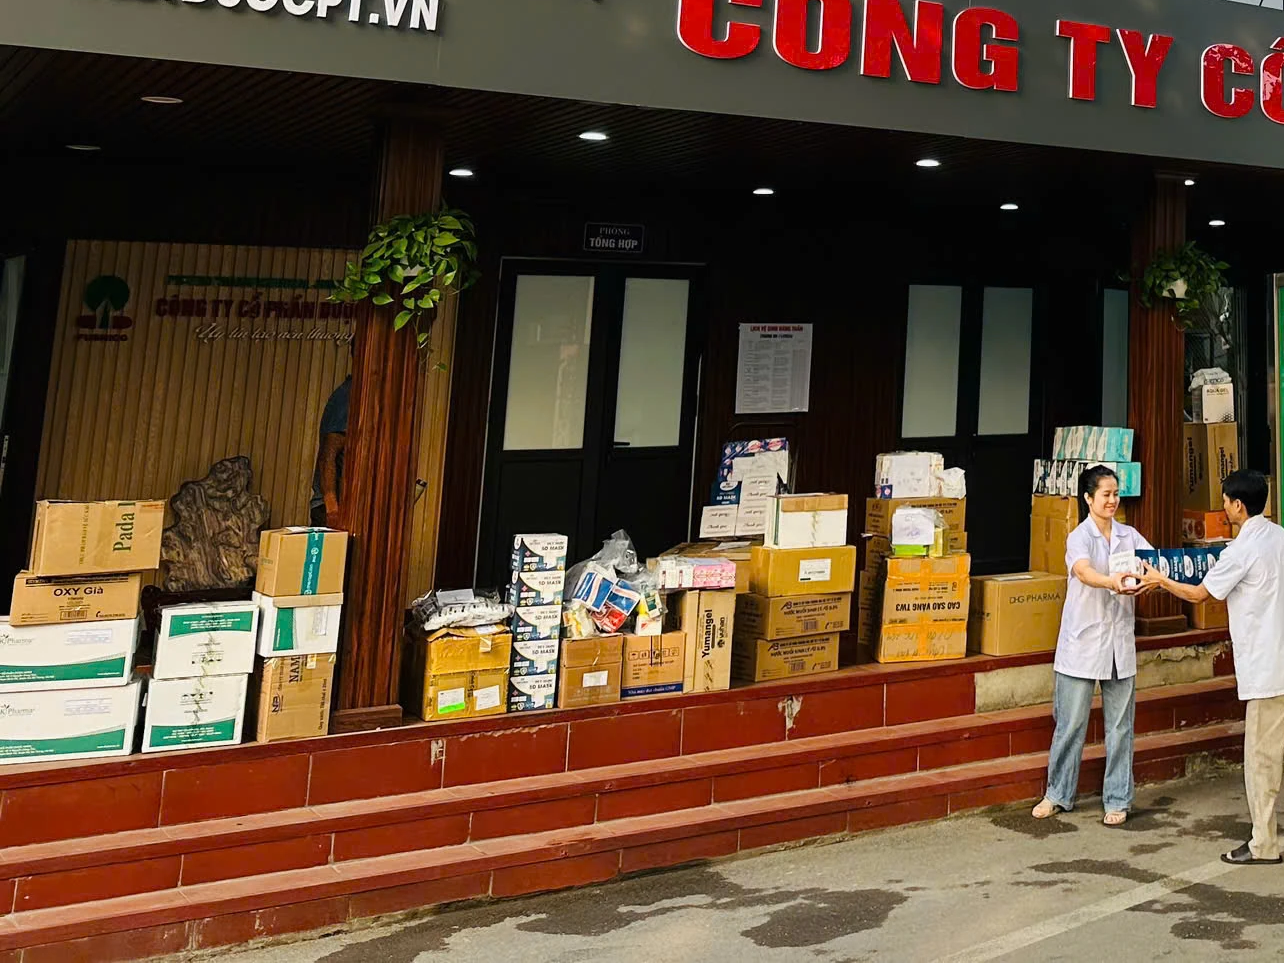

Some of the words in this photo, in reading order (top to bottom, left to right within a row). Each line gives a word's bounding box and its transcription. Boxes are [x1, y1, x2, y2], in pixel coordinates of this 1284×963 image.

[1056, 19, 1174, 109] TY
[112, 512, 136, 552] Pada
[53, 587, 80, 597] OXY
[1009, 594, 1025, 604] DHG
[1026, 592, 1061, 603] PHARMA
[895, 603, 911, 612] TW3
[912, 602, 931, 612] VÀNG
[932, 602, 946, 610] SAO
[947, 601, 961, 610] CAO
[701, 609, 714, 659] Yumangel
